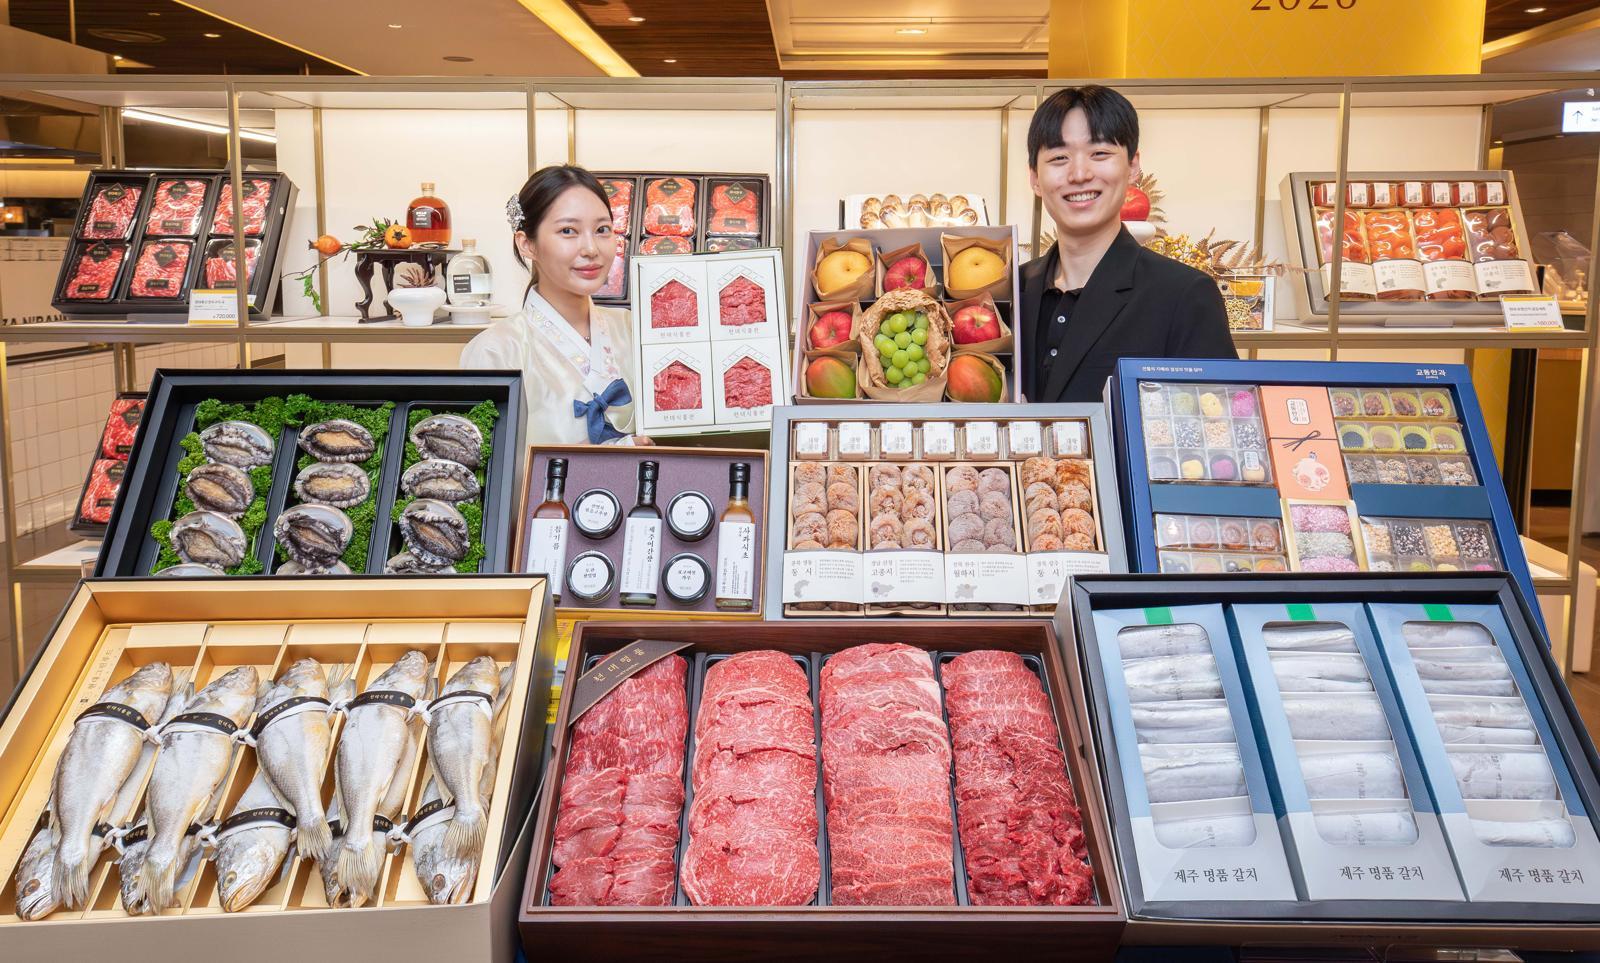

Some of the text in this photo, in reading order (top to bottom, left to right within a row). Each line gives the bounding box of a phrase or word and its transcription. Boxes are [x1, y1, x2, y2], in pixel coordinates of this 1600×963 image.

[593, 648, 645, 682] 현대명품
[1174, 868, 1258, 883] 제주 명품 갈치
[1340, 866, 1424, 880] 제주 명품 갈치
[1498, 868, 1584, 884] 제주 명품 갈치
